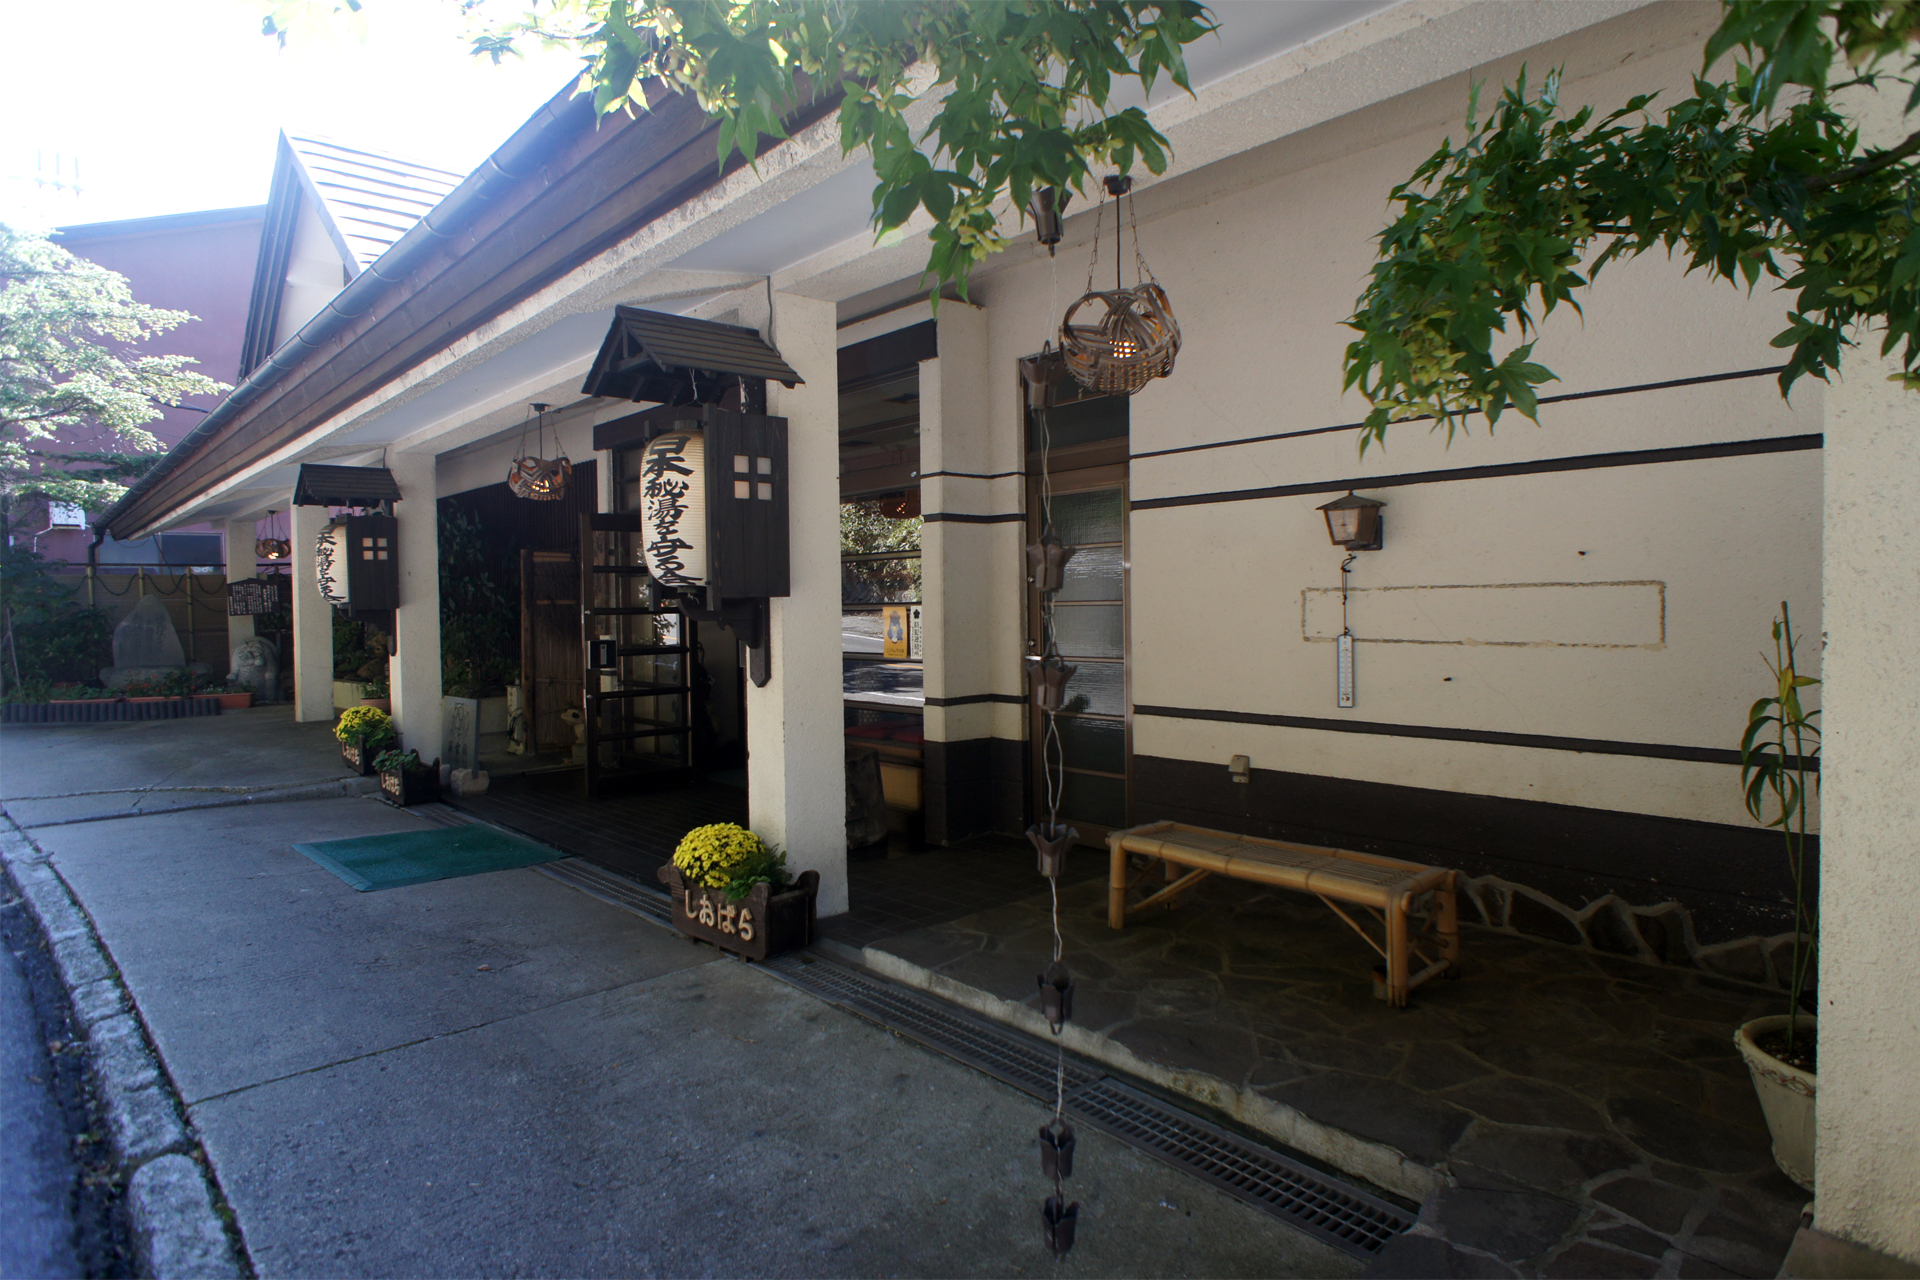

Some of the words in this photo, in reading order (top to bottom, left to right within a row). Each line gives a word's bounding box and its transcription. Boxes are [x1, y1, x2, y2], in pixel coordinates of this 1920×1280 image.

[642, 436, 704, 585] 日本秘湯を守る会
[685, 889, 755, 941] しおばら
